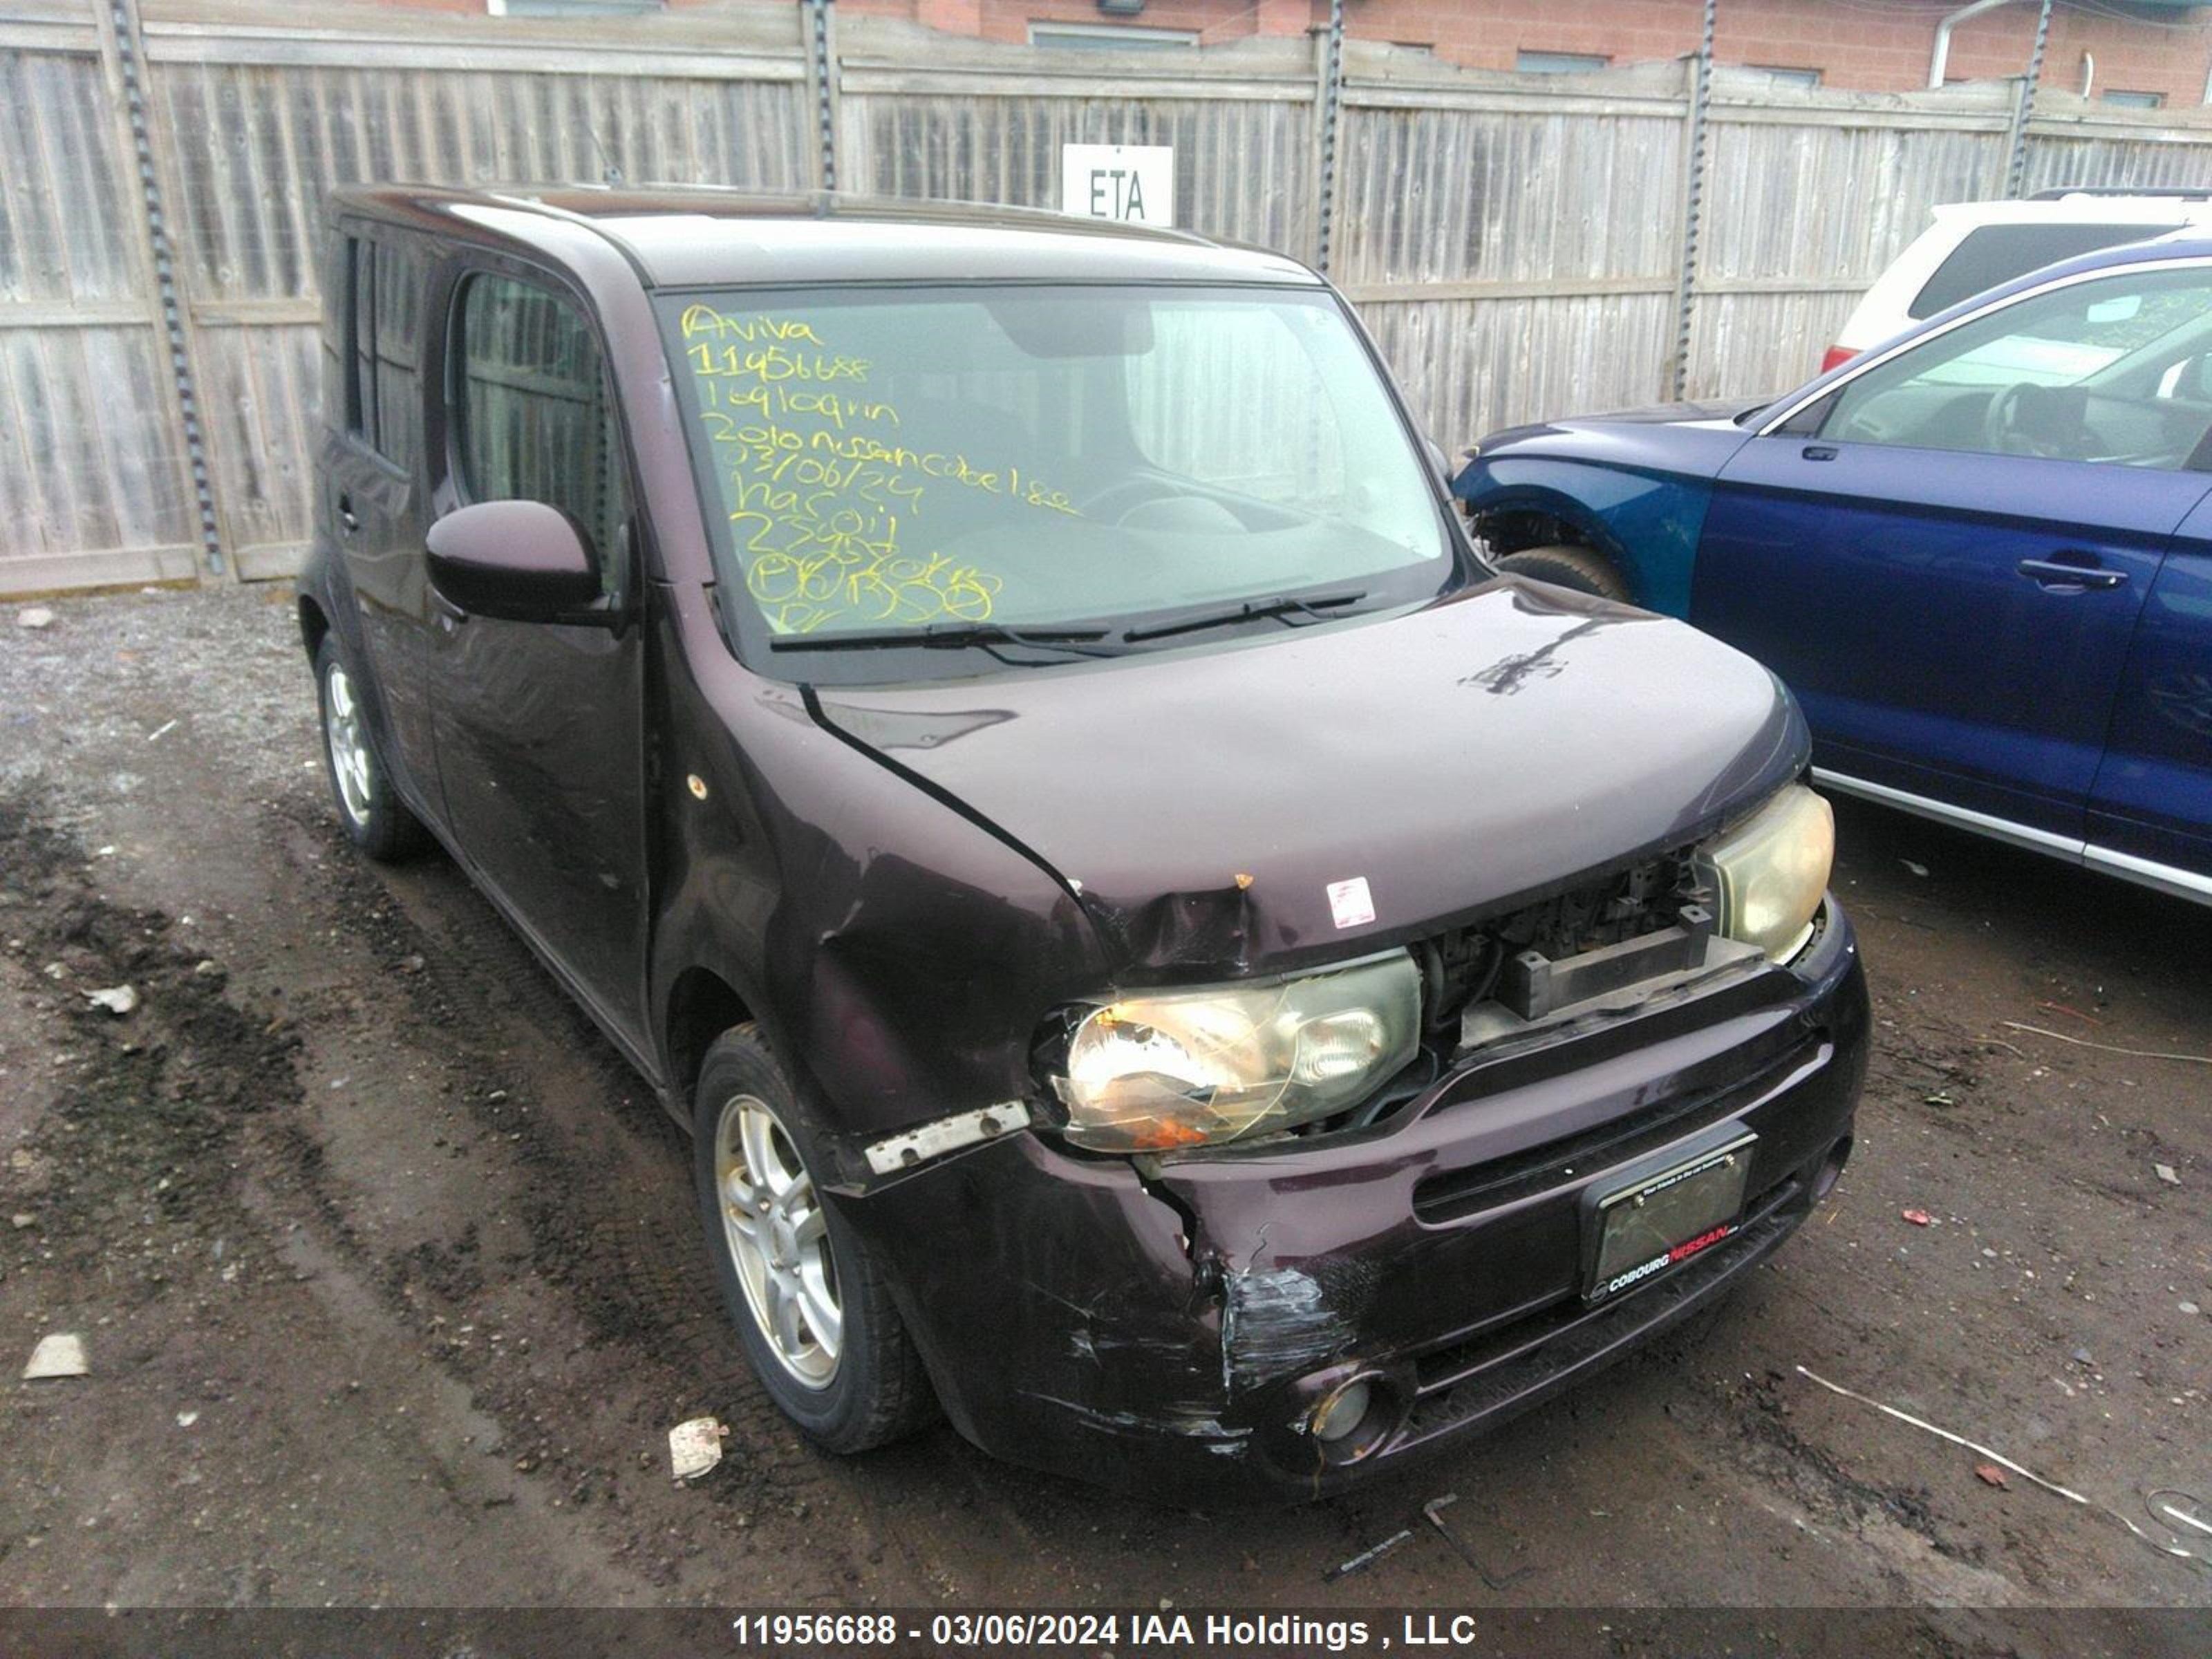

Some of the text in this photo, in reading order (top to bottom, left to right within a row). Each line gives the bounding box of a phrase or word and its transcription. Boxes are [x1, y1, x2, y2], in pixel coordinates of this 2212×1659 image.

[1090, 169, 1145, 221] ETA
[681, 304, 825, 346] Aviva
[700, 412, 803, 451] 2010
[1609, 1226, 1728, 1292] COBOURG NISSAN
